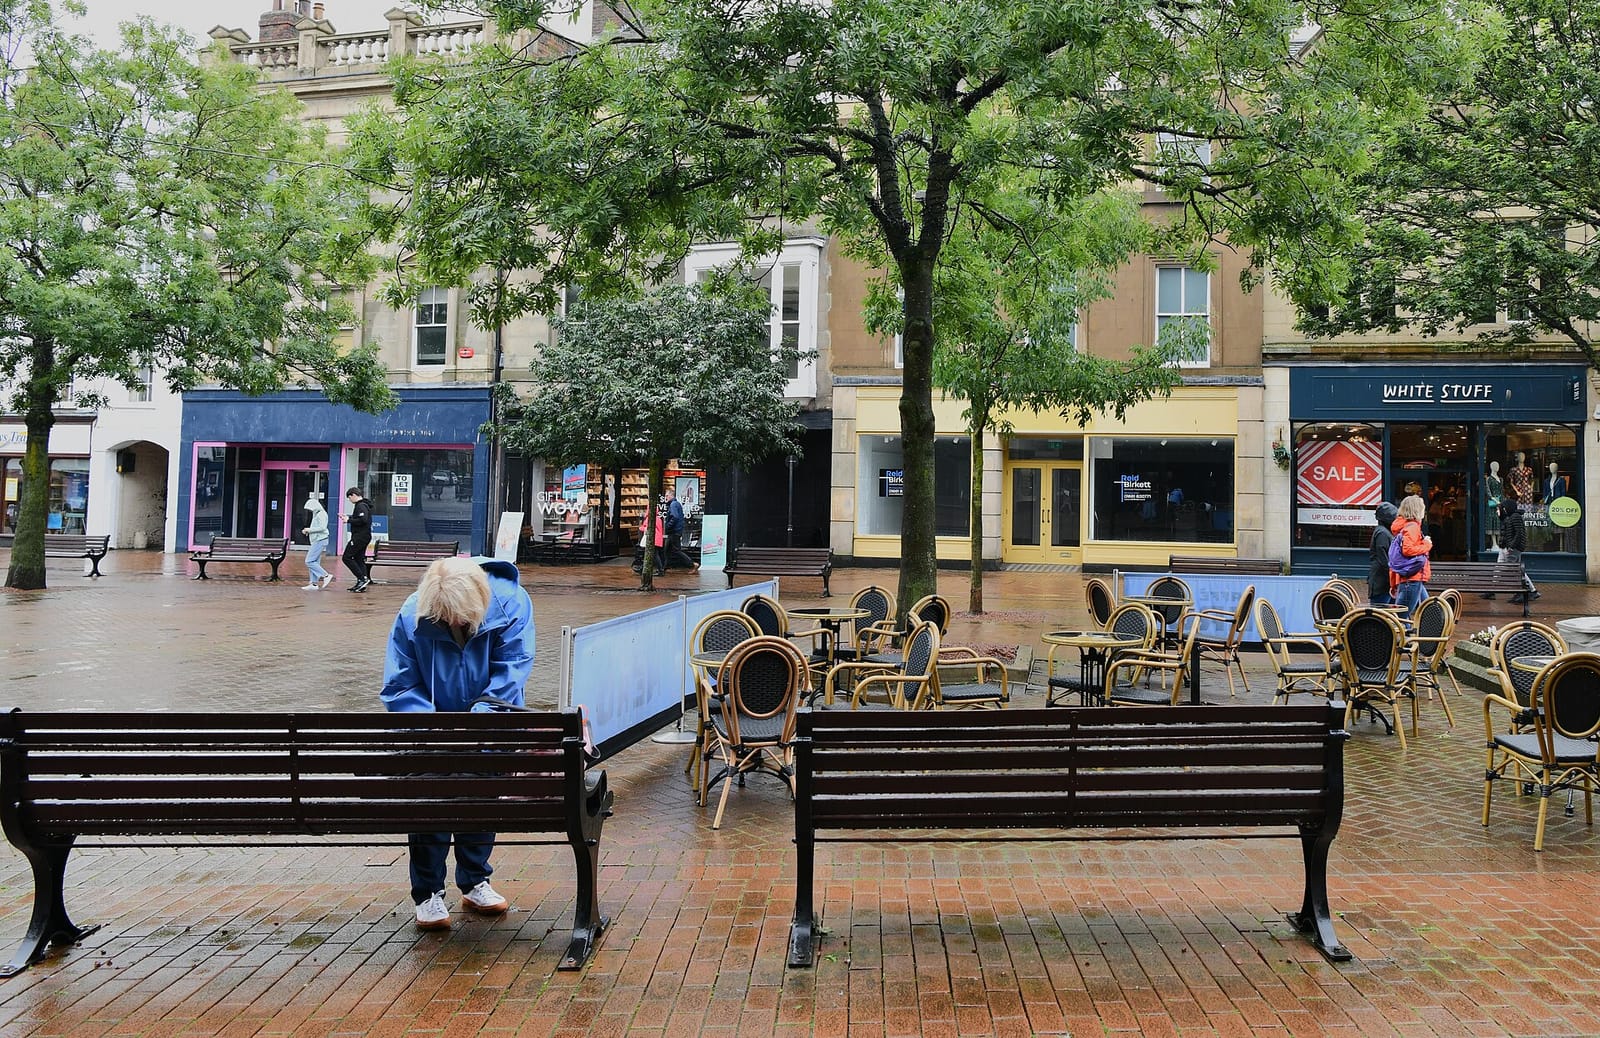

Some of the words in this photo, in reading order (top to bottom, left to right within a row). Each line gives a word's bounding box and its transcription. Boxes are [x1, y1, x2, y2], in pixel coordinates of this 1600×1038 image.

[1383, 383, 1434, 398] WHITE
[1440, 383, 1494, 398] STUFF
[1313, 466, 1366, 481] SALE
[1123, 481, 1151, 489] Birkett
[536, 491, 560, 502] GIFT
[537, 502, 583, 516] WOW
